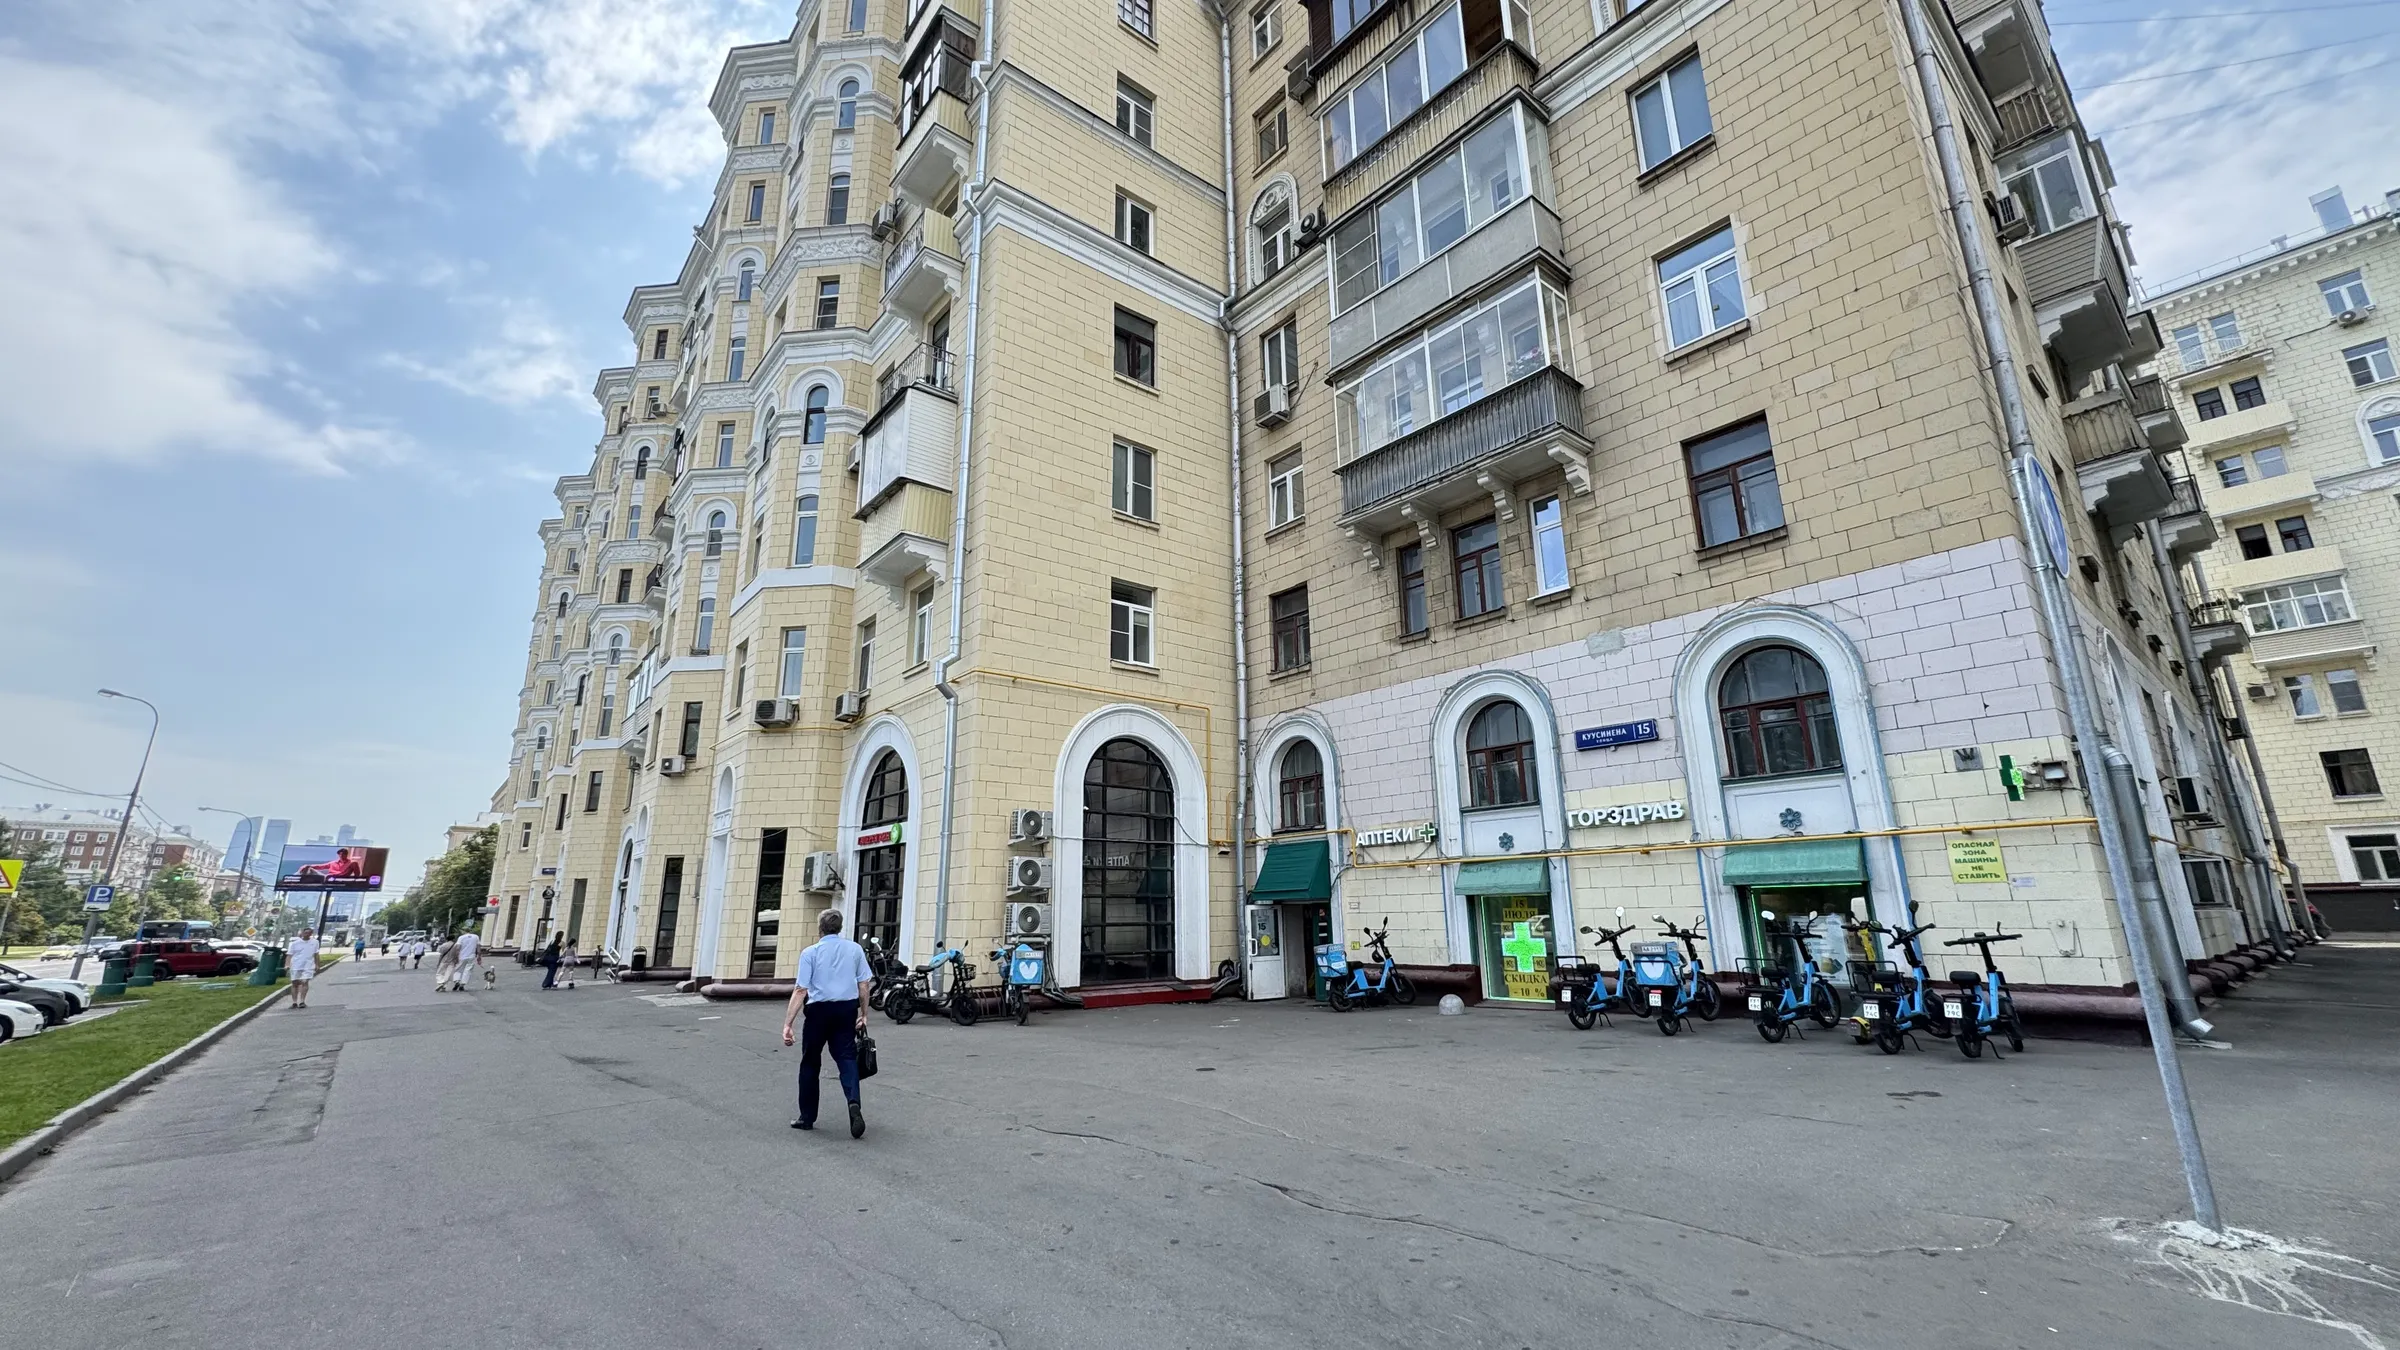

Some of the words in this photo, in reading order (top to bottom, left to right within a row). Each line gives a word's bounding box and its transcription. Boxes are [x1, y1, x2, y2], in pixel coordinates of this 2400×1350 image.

[1582, 728, 1627, 741] КУУСИНЕНА
[1637, 723, 1650, 735] 15
[1568, 800, 1685, 828] ГОРЗДРАВ
[1356, 827, 1415, 847] АПТЕКИ
[1951, 841, 1995, 849] ОПАСНАЯ
[1515, 900, 1524, 908] 15
[1504, 910, 1536, 920] ИЮЛЯ
[1258, 922, 1267, 931] 15
[1504, 974, 1547, 984] СКИДКА
